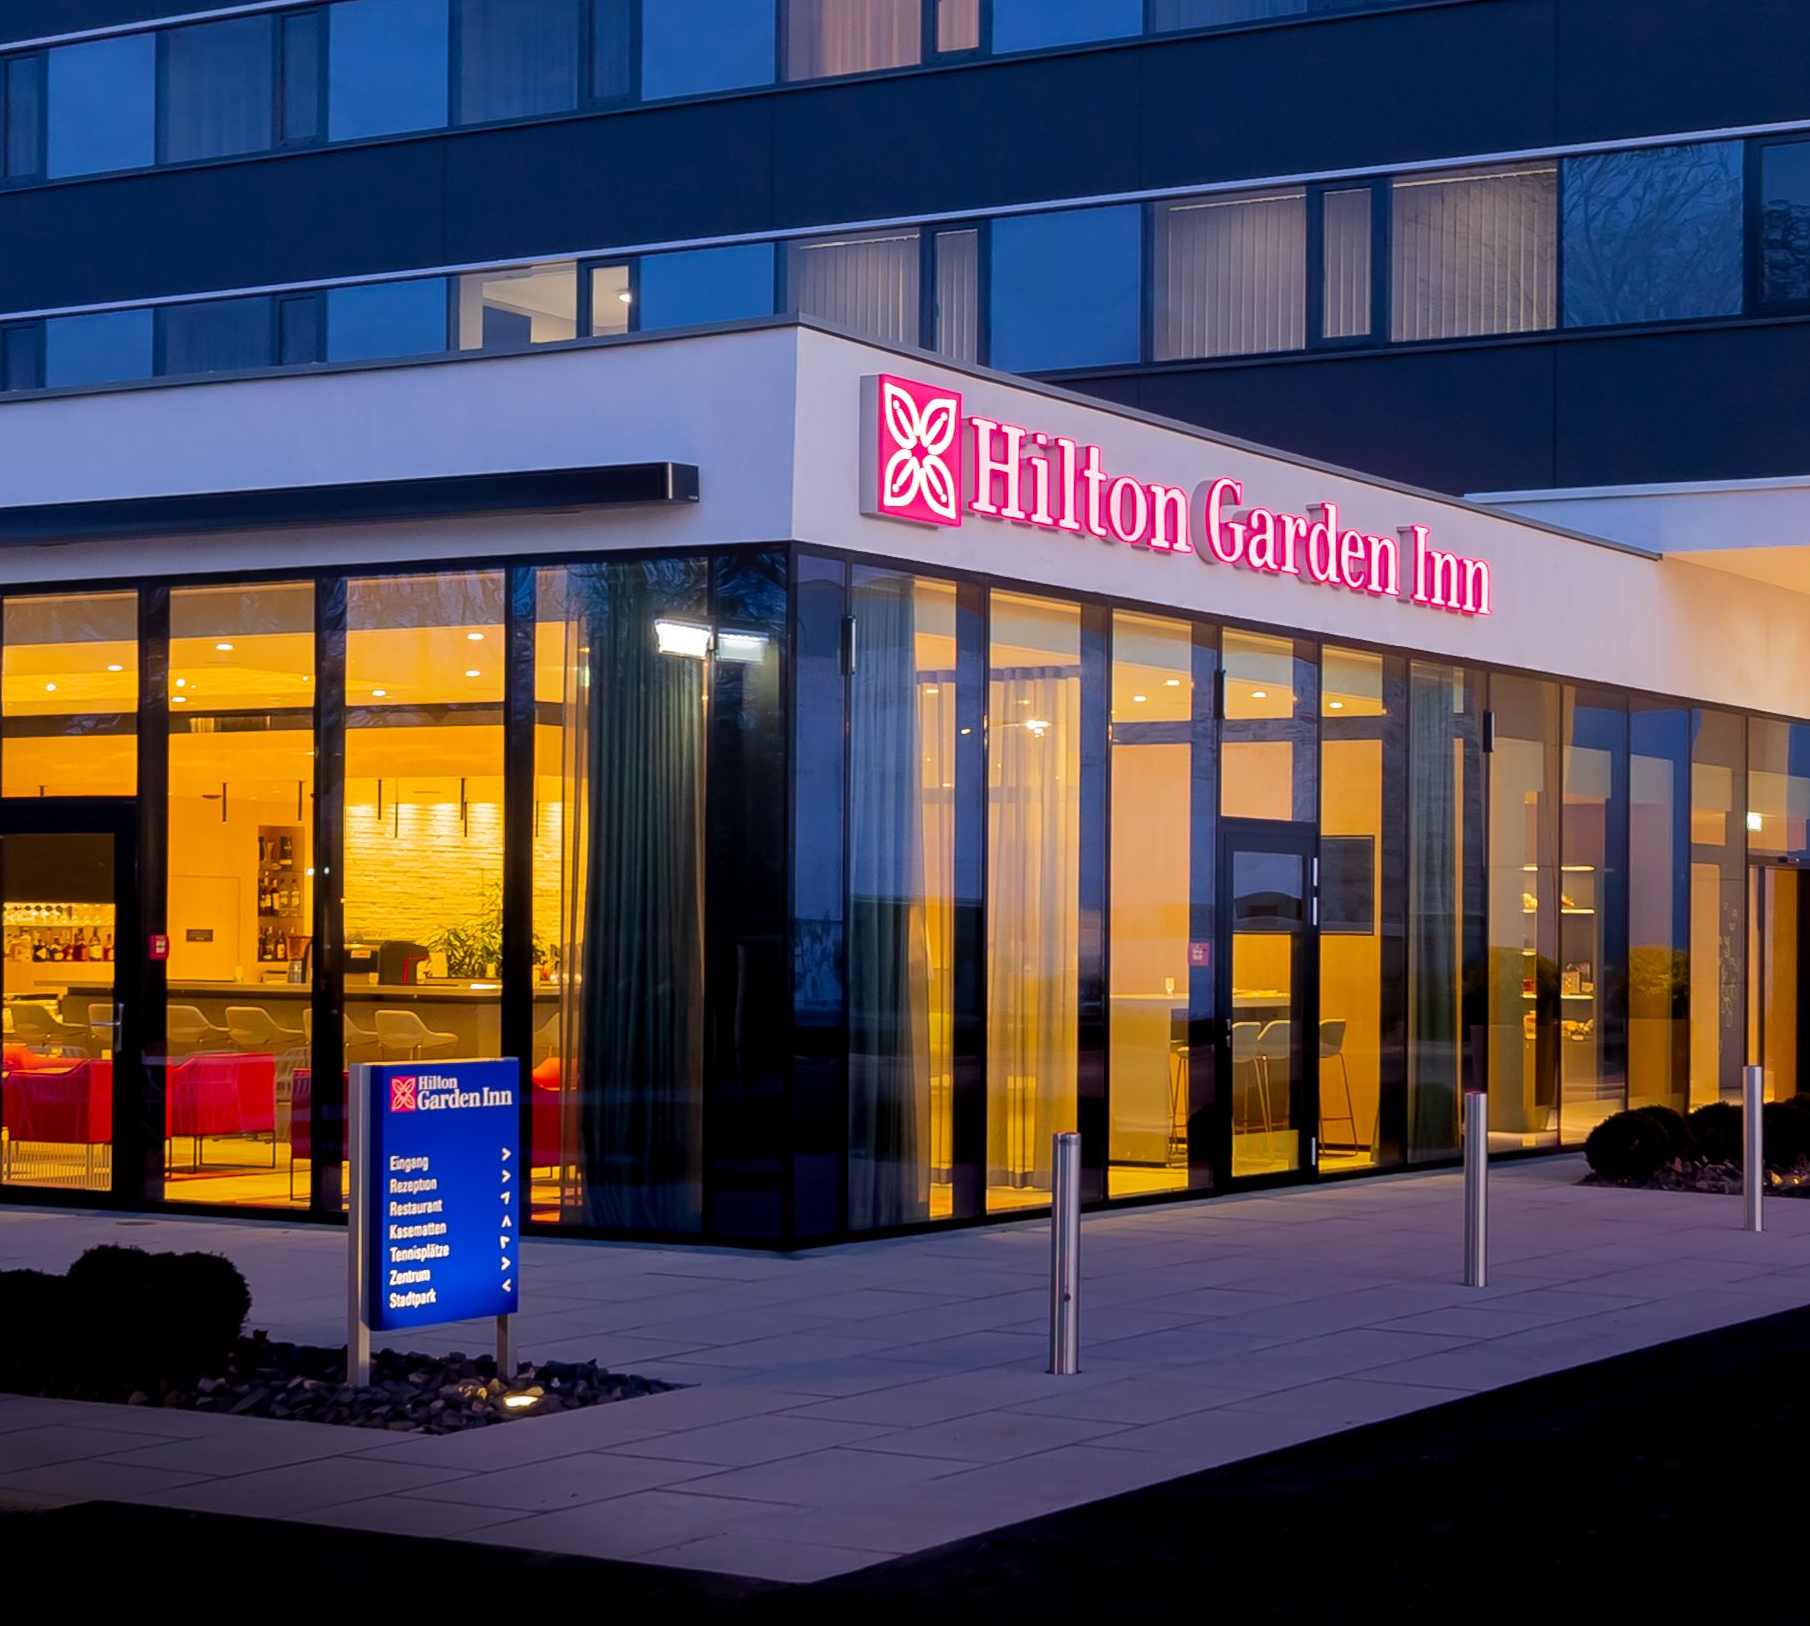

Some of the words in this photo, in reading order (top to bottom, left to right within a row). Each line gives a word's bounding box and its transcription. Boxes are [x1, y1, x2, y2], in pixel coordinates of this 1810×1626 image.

[969, 417, 1192, 554] Hilton
[1205, 477, 1400, 596] Garden
[1409, 524, 1493, 617] Inn
[418, 1075, 458, 1090] Hilton
[417, 1088, 481, 1111] Garden
[482, 1087, 513, 1107] Inn
[389, 1155, 429, 1173] Eingang
[389, 1178, 437, 1195] Rezeption
[389, 1199, 443, 1217] Restaurant
[389, 1221, 447, 1240] Kasematten
[389, 1243, 450, 1262] Tennisplätze
[389, 1266, 431, 1286] Zentrum
[389, 1288, 437, 1309] Stadtpark
